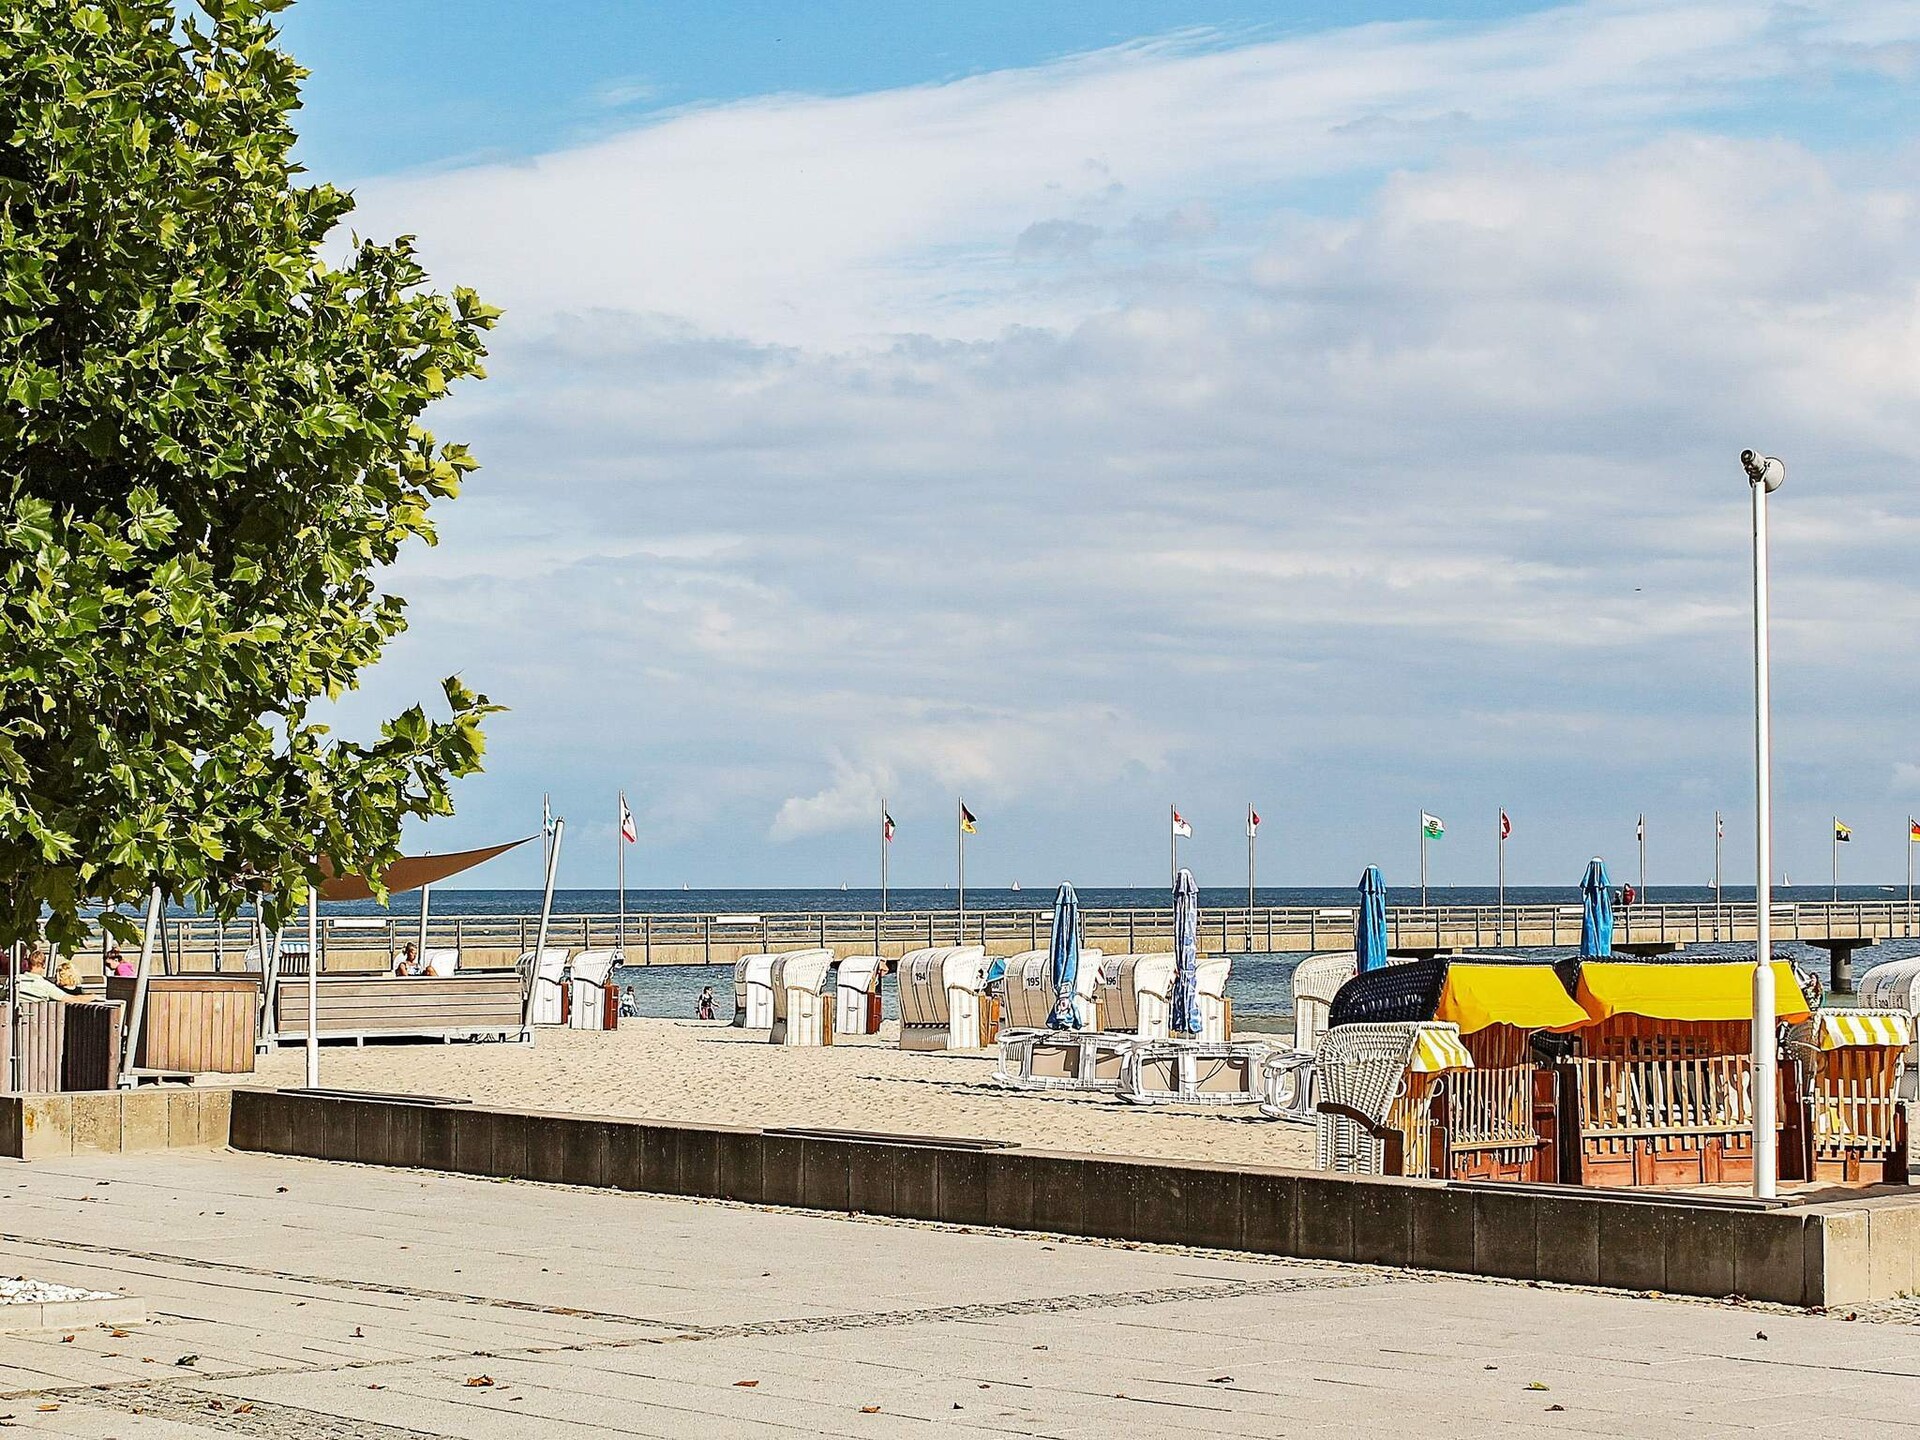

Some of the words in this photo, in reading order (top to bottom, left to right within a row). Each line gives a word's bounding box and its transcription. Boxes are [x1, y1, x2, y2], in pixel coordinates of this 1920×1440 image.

[915, 972, 926, 981] 194
[1026, 976, 1040, 986] 195
[1106, 976, 1116, 985] 196
